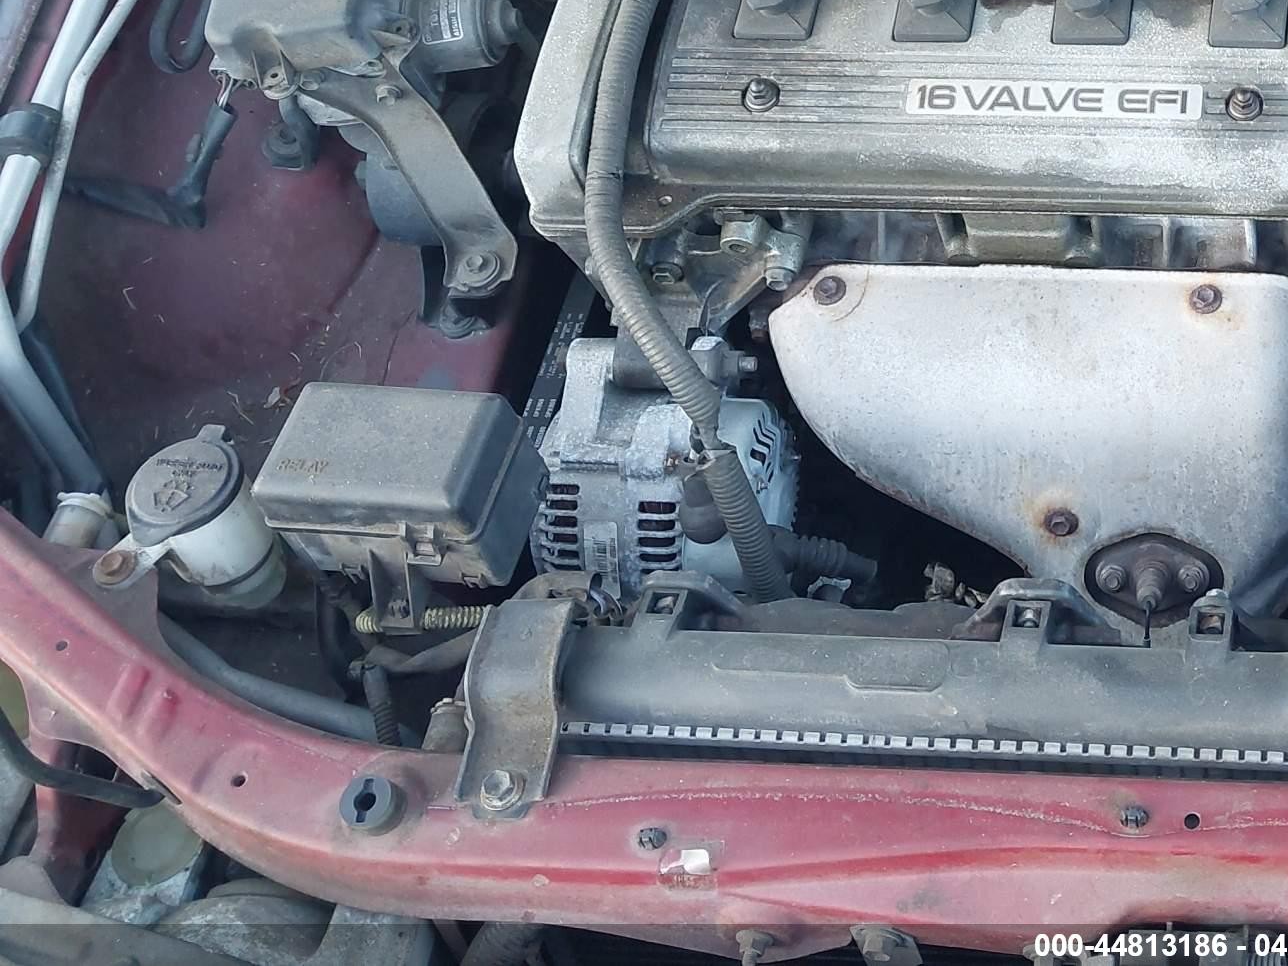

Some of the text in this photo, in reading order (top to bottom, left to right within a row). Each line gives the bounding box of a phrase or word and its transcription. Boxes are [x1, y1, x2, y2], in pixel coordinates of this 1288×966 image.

[916, 84, 1188, 115] 16 VALVE EFI
[276, 457, 330, 475] RELAY
